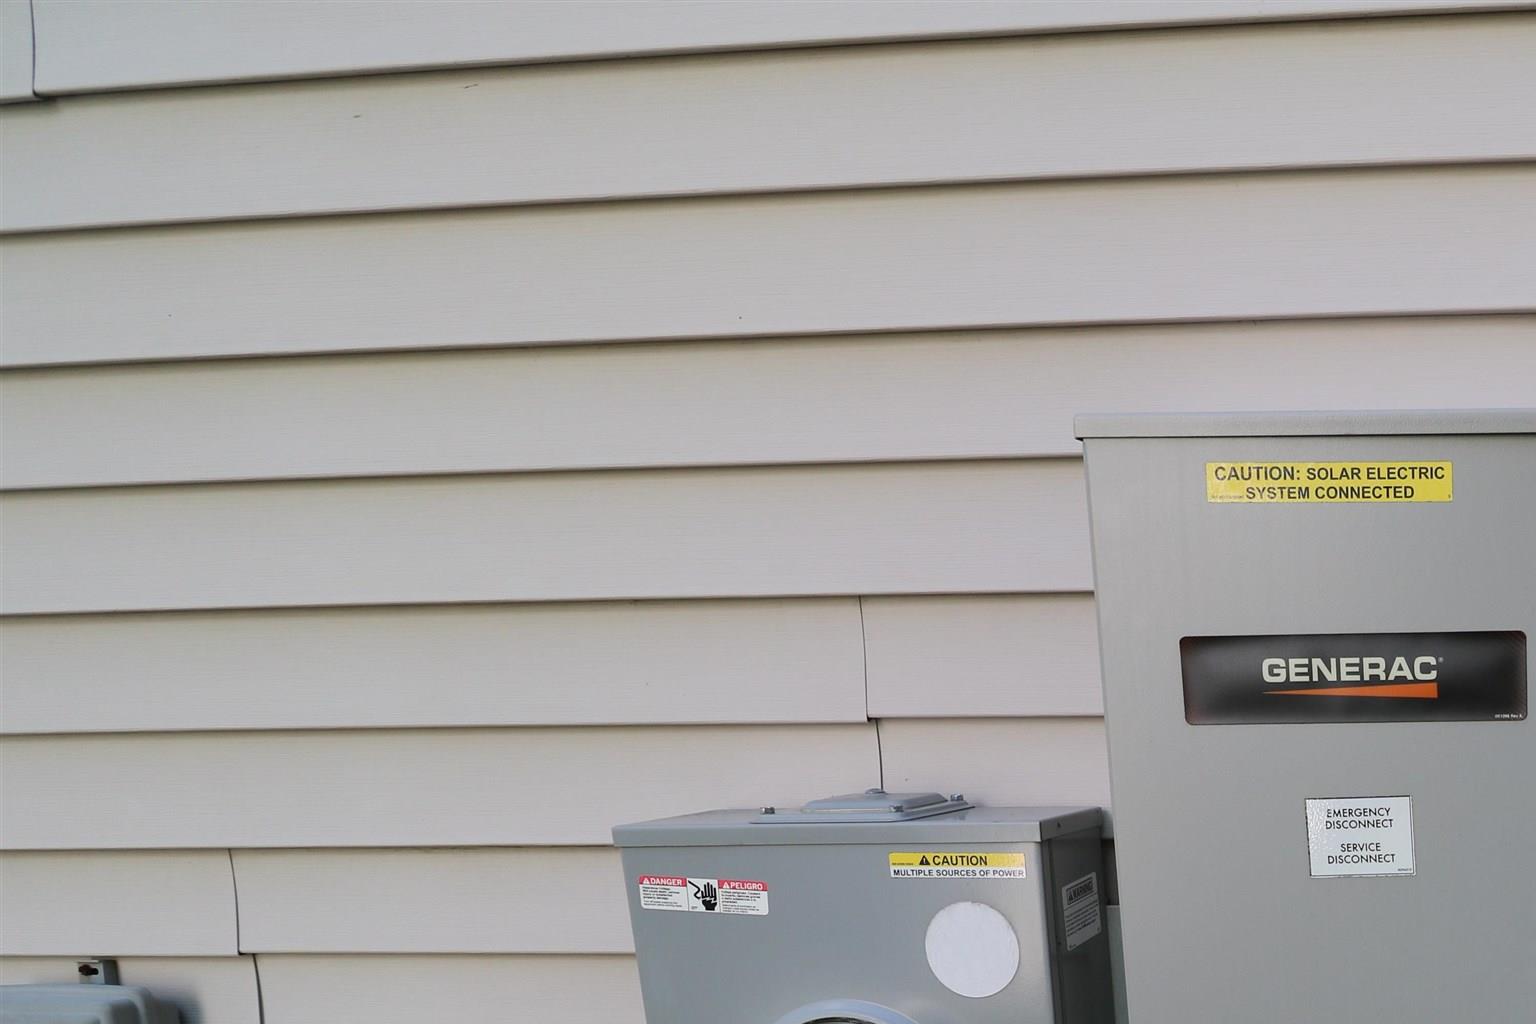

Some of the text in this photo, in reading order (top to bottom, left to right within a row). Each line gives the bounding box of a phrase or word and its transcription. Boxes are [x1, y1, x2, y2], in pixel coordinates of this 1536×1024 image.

[1214, 466, 1445, 481] CAUTION: SOLAR ELECTRIC
[1245, 485, 1415, 500] SYSTEM CONNECTED
[1261, 656, 1437, 684] GENERAC
[1326, 807, 1391, 818] EMERGENCY
[1325, 819, 1394, 830] DISCONNECT
[1340, 842, 1381, 852] SERVICE
[932, 855, 988, 866] CAUTION
[1327, 853, 1396, 864] DISCONNECT
[893, 869, 1024, 877] MULTIPLE SOURCES OF POWER
[650, 877, 683, 885] DANGER
[730, 881, 763, 890] PELIGRO
